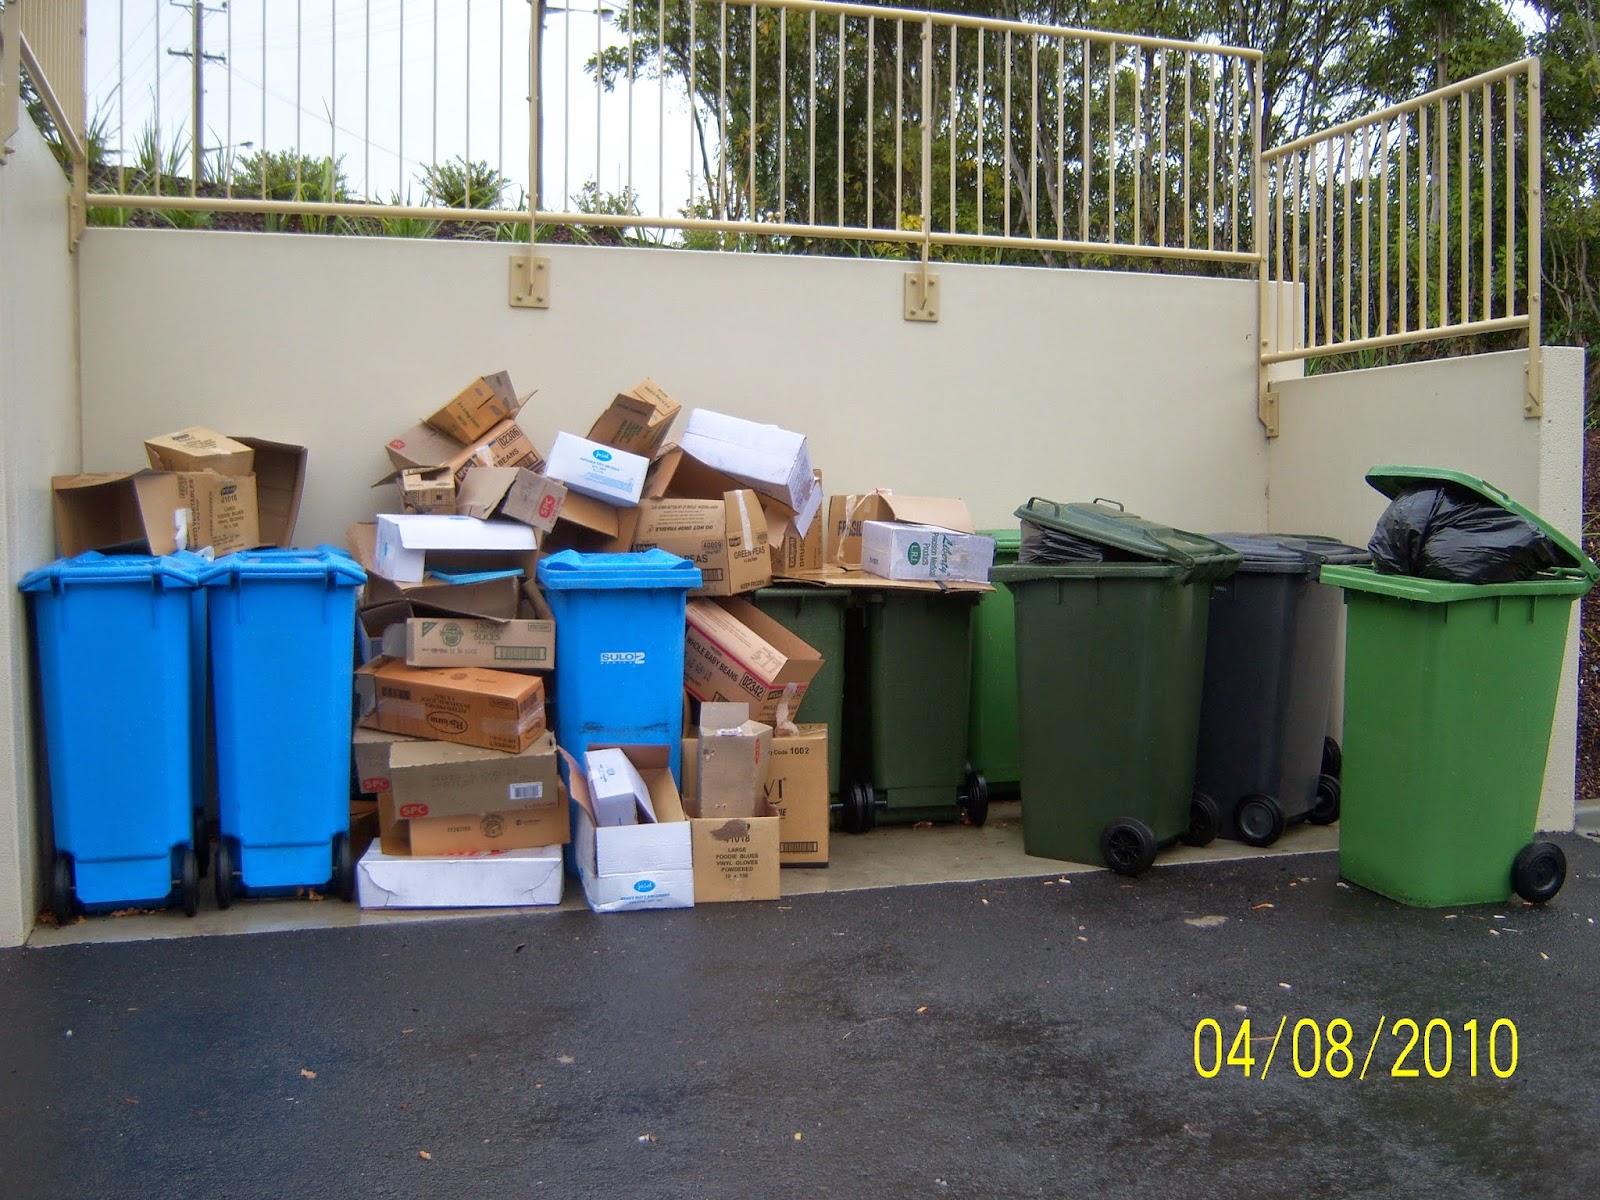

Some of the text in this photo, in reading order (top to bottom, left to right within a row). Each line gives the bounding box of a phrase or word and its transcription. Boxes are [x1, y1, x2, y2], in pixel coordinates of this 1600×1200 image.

[500, 427, 520, 446] 02306
[498, 448, 519, 467] BEANS
[189, 480, 197, 527] VEGETABLES
[540, 496, 553, 516] SPC
[683, 554, 708, 563] PEAS
[734, 546, 765, 559] GREEN PEAS
[922, 543, 930, 565] Products
[929, 532, 939, 577] Precision Medical
[938, 534, 952, 573] Liberty
[687, 636, 706, 656] WHOLE
[704, 651, 720, 667] BABY
[719, 663, 738, 681] BEANS
[742, 675, 764, 698] 02342
[430, 716, 463, 730] Riviana
[366, 779, 388, 788] SPC
[402, 806, 426, 815] SPC
